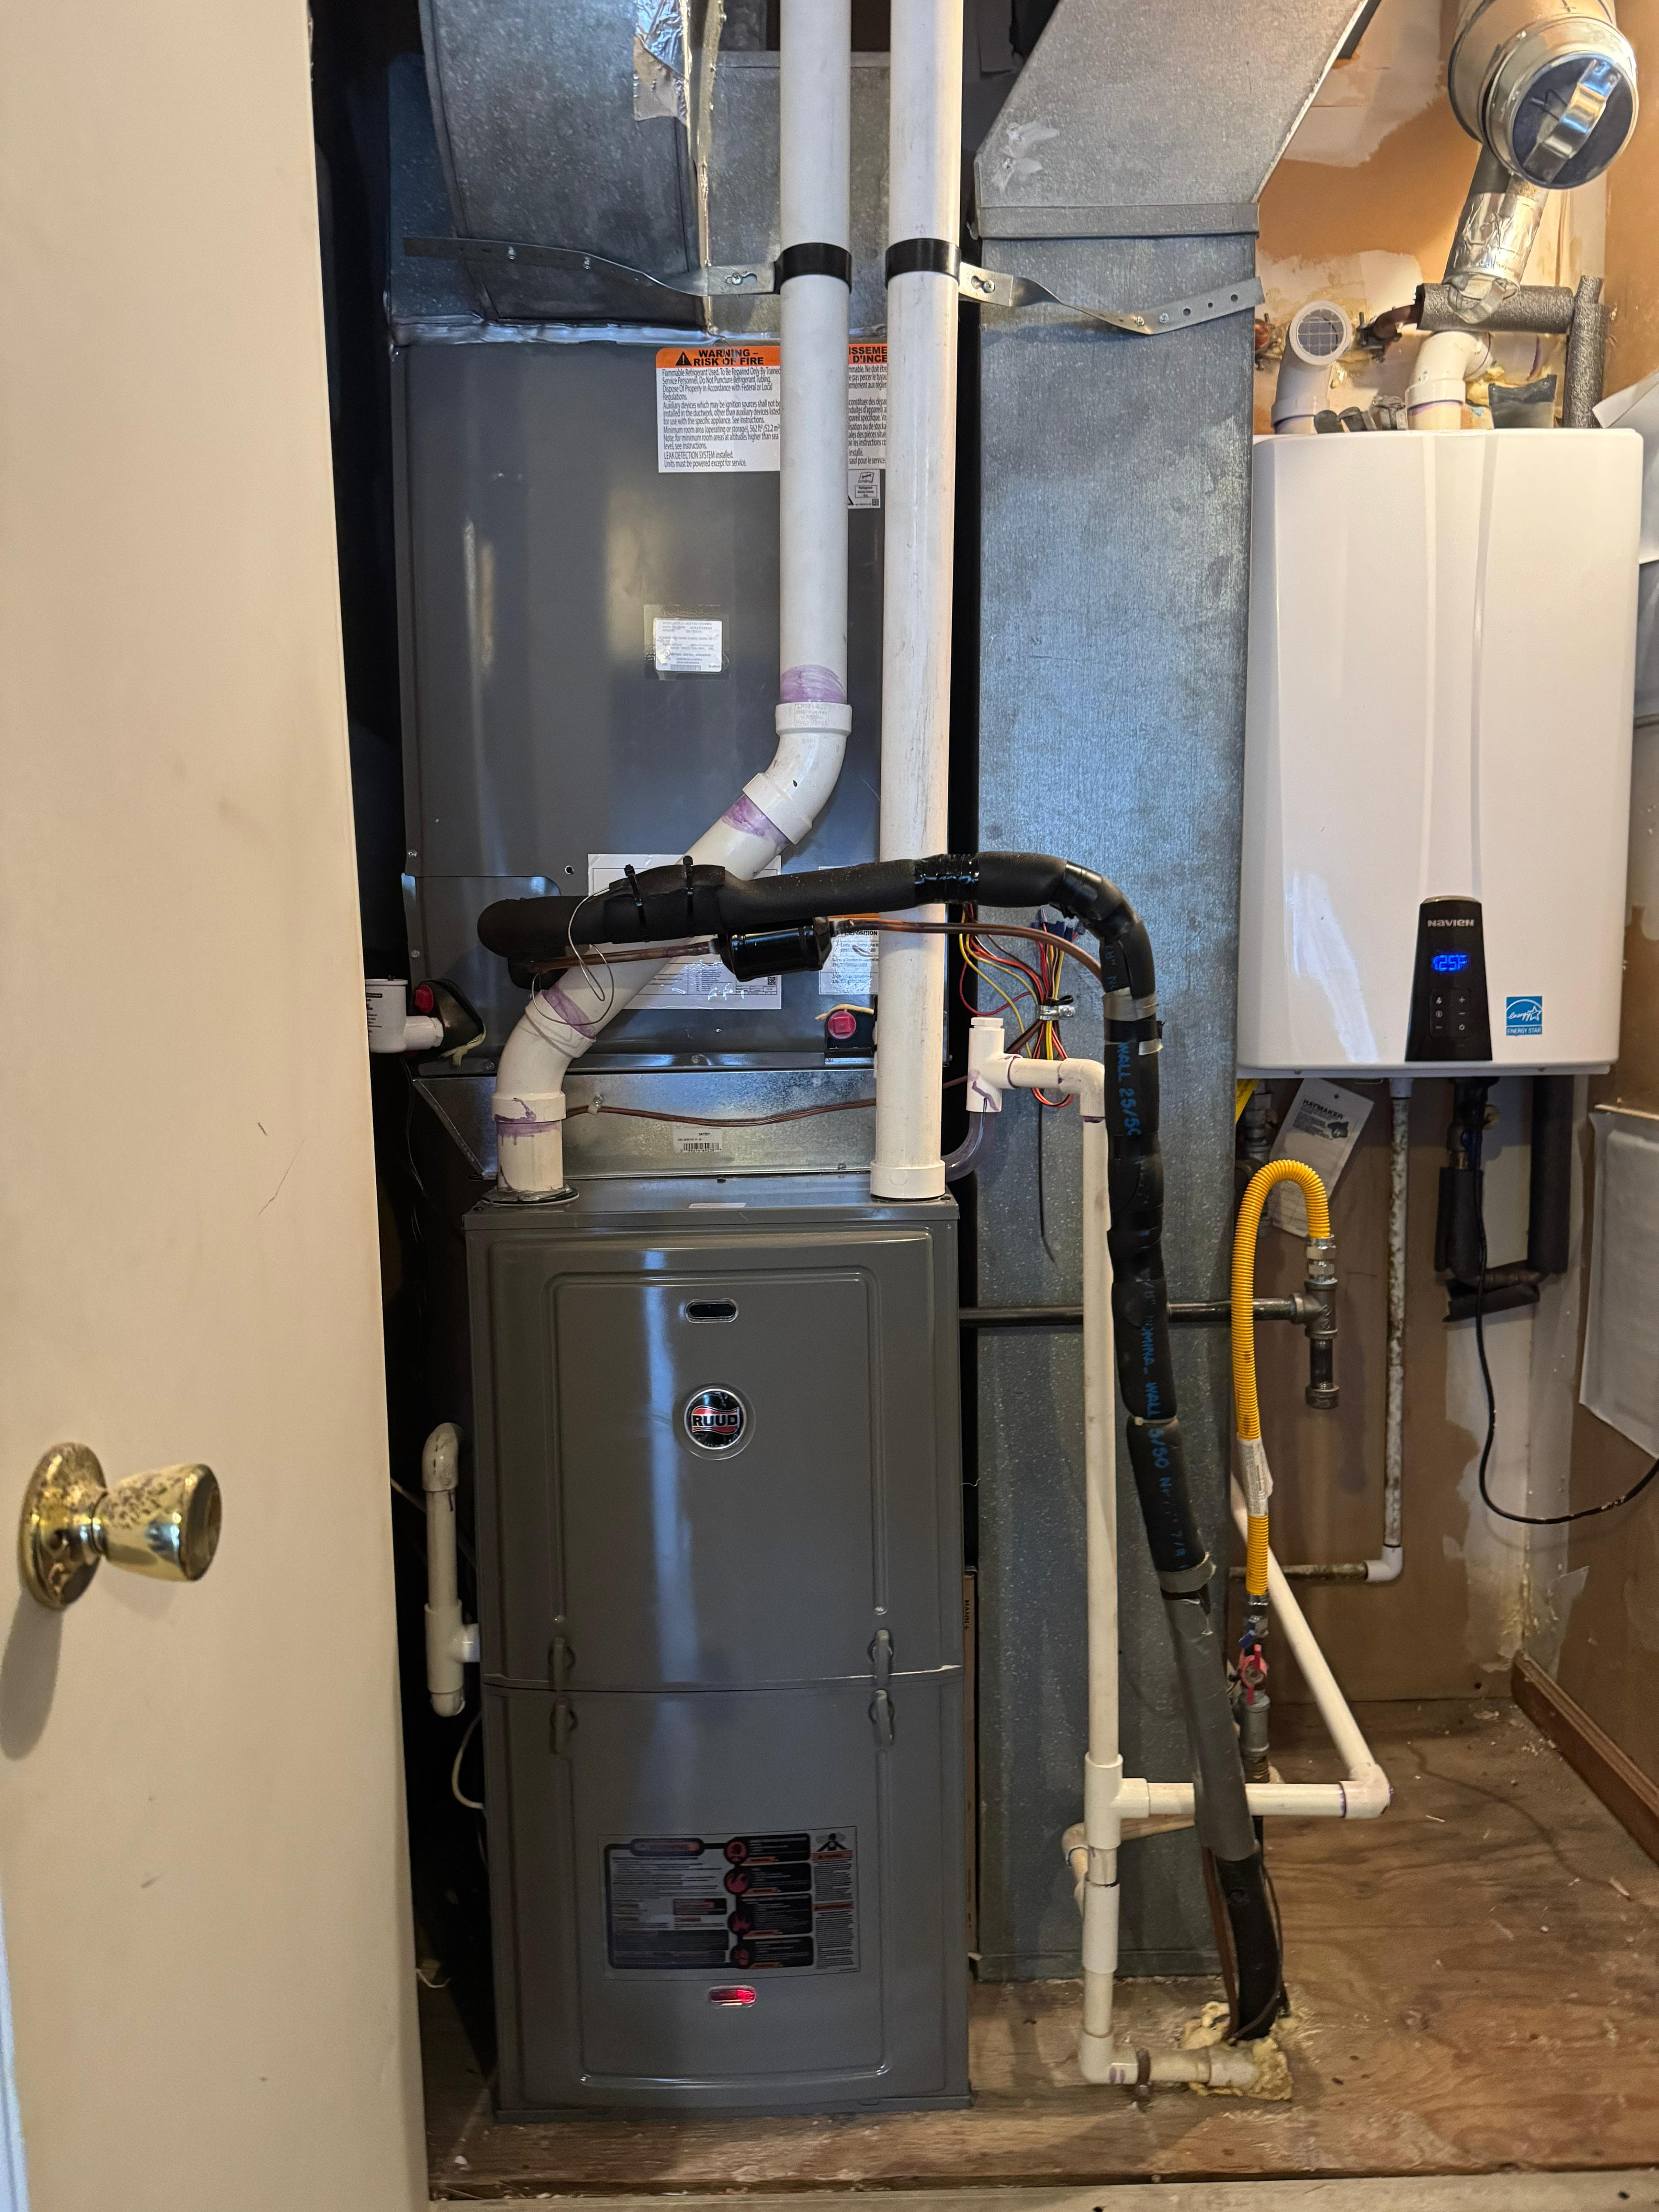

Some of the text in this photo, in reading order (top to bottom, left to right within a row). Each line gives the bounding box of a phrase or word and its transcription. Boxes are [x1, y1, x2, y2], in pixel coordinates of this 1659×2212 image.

[698, 349, 750, 357] WARNING
[694, 358, 719, 366] RISK
[740, 357, 764, 365] FIRE
[685, 368, 708, 378] Refrigerant
[731, 367, 750, 377] Repaired
[750, 367, 760, 377] Only
[663, 376, 677, 385] Service
[714, 375, 732, 384] Puncture
[733, 375, 756, 385] Refrigerant
[663, 384, 679, 394] Dispose
[685, 384, 702, 394] Properly
[708, 383, 731, 391] Accordance
[731, 383, 741, 391] with
[741, 383, 756, 391] Federal
[762, 382, 772, 391] Local
[681, 400, 696, 409] devices
[696, 400, 709, 409] which
[719, 400, 725, 408] be
[725, 399, 741, 410] ignition
[758, 399, 767, 407] shall
[664, 409, 680, 417] installed
[714, 408, 725, 416] other
[726, 408, 735, 416] than
[736, 407, 753, 417] auxiliary
[753, 407, 768, 416] devices
[769, 406, 780, 415] listed
[729, 432, 747, 440] altitudes
[748, 432, 761, 442] higher
[675, 451, 698, 459] DETECTION
[699, 451, 715, 459] SYSTEM
[693, 459, 710, 469] powered
[711, 459, 725, 468] except
[1302, 1099, 1343, 1120] HAYMAKER
[1145, 1382, 1161, 1418] WALL
[693, 1414, 738, 1427] RUUD
